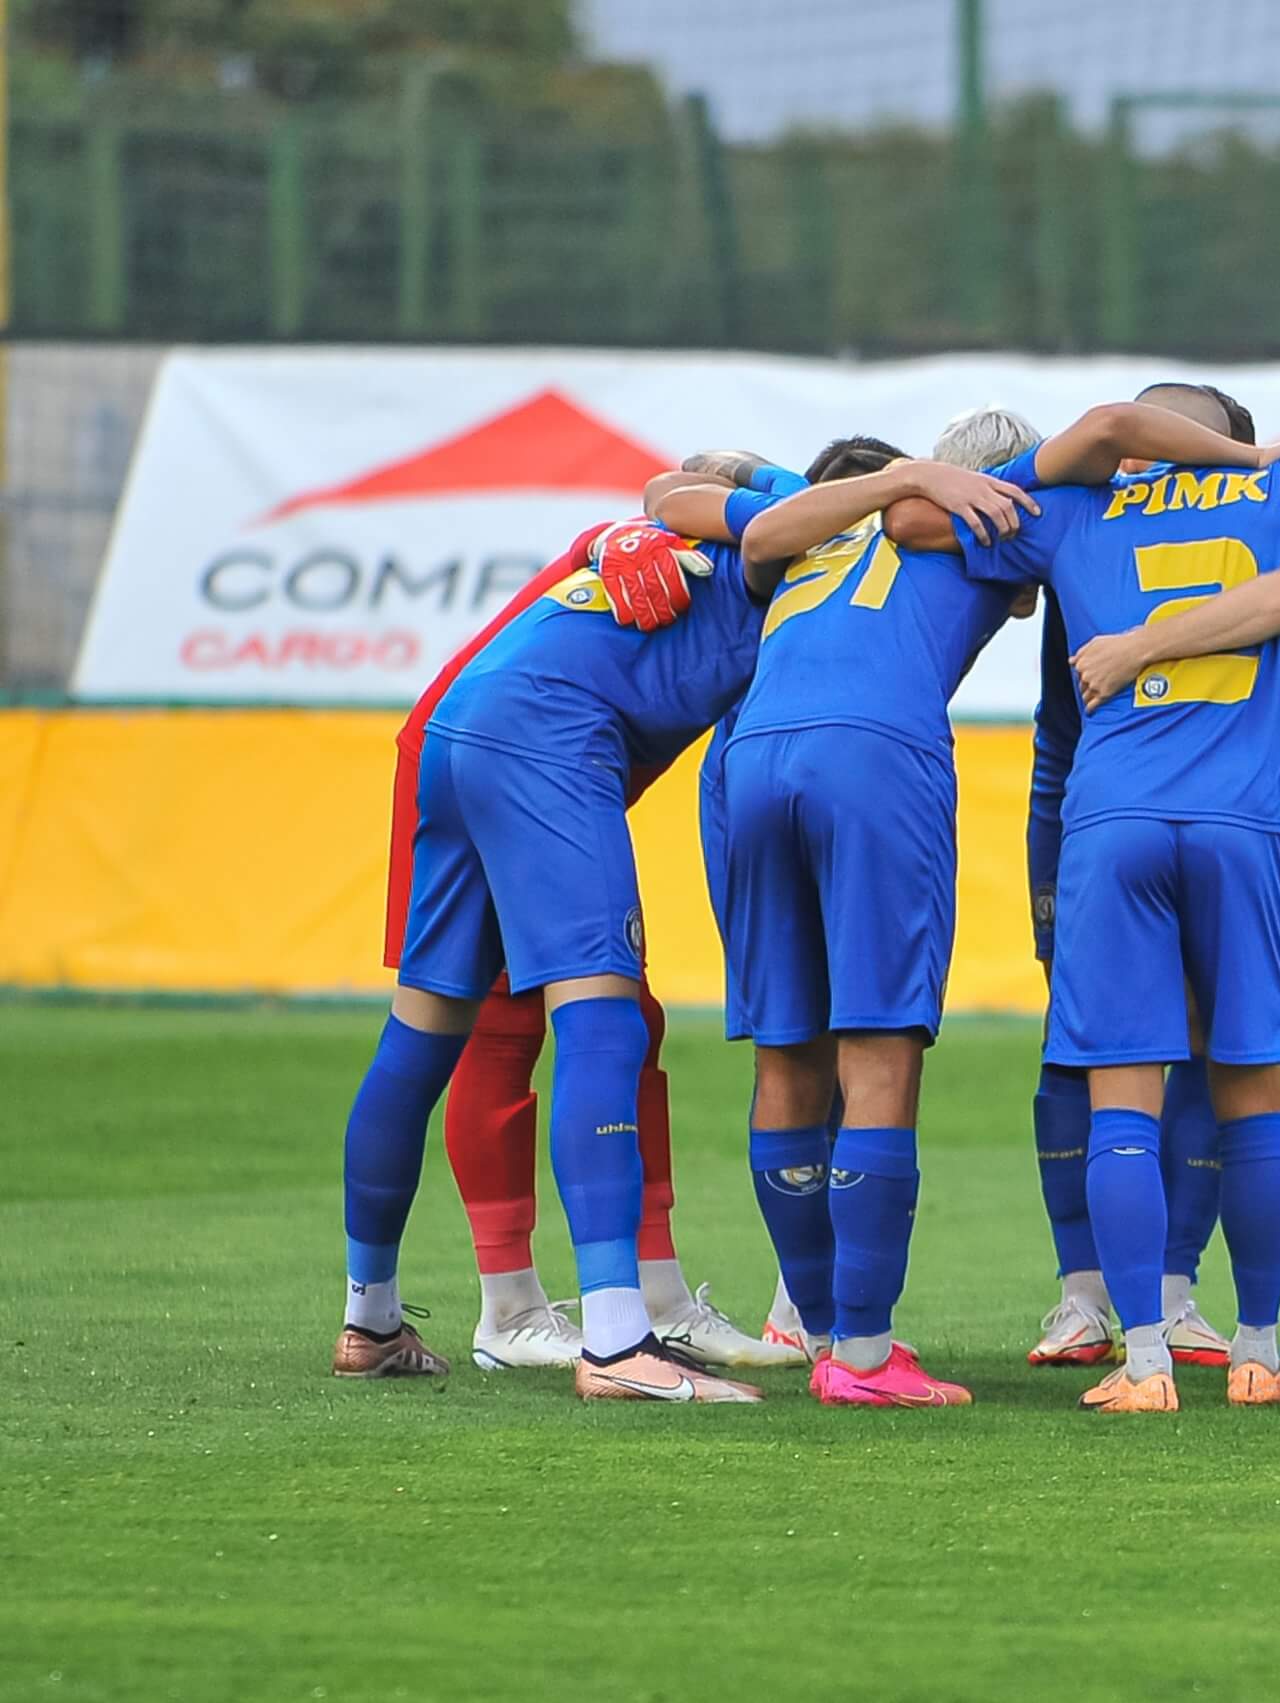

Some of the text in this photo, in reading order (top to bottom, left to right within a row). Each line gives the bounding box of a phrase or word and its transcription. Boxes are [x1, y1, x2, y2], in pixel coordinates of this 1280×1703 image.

[1102, 470, 1269, 520] PIMK
[1133, 536, 1260, 708] 2
[180, 626, 422, 672] CARGO
